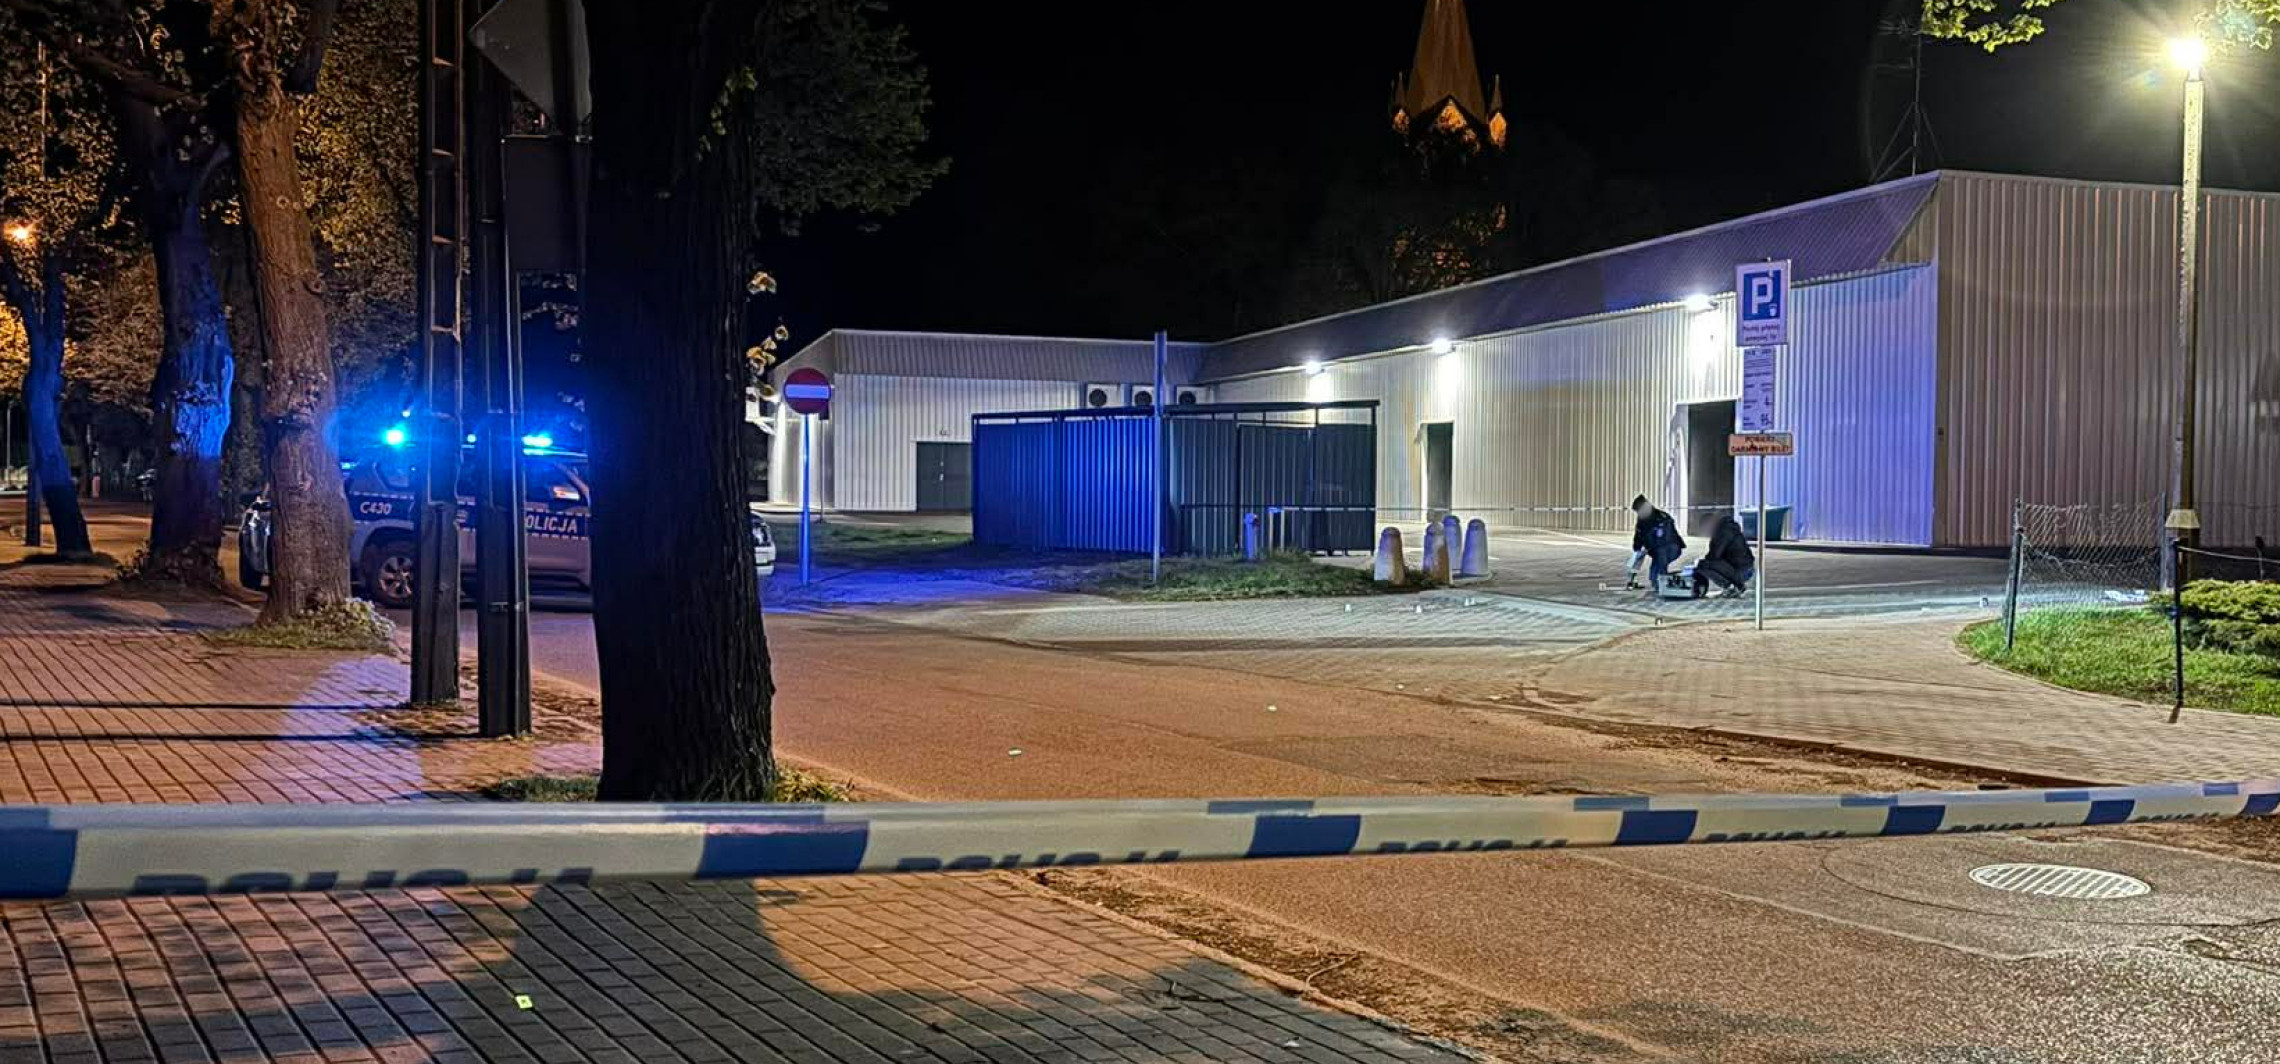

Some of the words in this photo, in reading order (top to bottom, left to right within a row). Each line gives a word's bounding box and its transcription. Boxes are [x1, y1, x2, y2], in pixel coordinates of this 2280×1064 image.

[1751, 276, 1774, 315] P
[359, 501, 392, 515] C430
[525, 514, 578, 534] OLICJA
